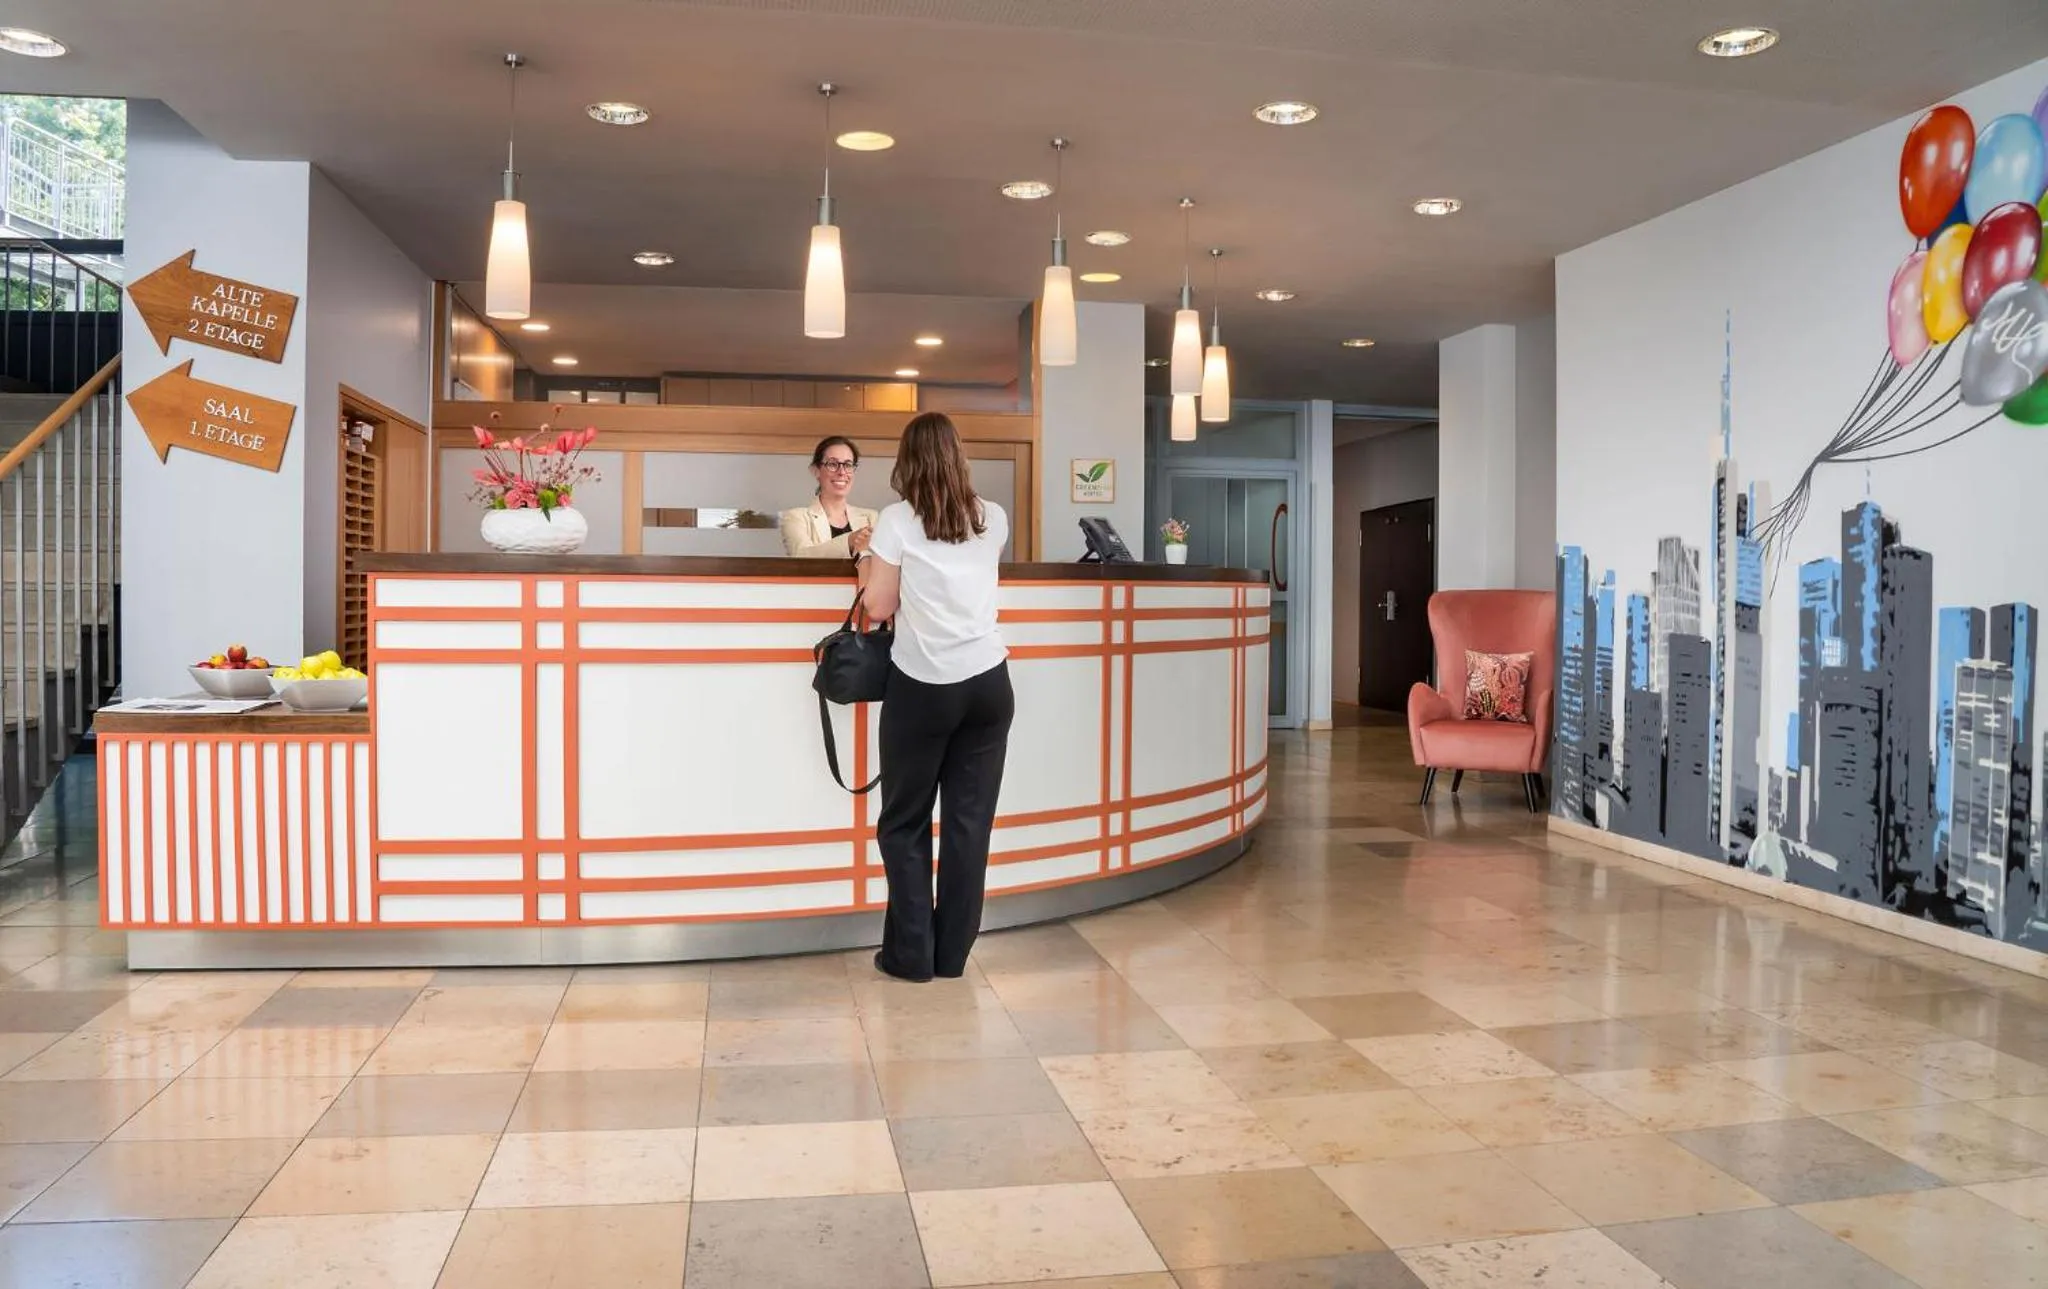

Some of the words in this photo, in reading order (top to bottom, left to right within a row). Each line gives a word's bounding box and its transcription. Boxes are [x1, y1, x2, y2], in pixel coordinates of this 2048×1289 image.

[211, 283, 265, 308] ALTE
[191, 295, 278, 330] KAPELLE
[204, 321, 266, 350] ETAGE
[204, 398, 255, 424] SAAL
[189, 420, 201, 436] 1.
[204, 423, 266, 451] ETAGE
